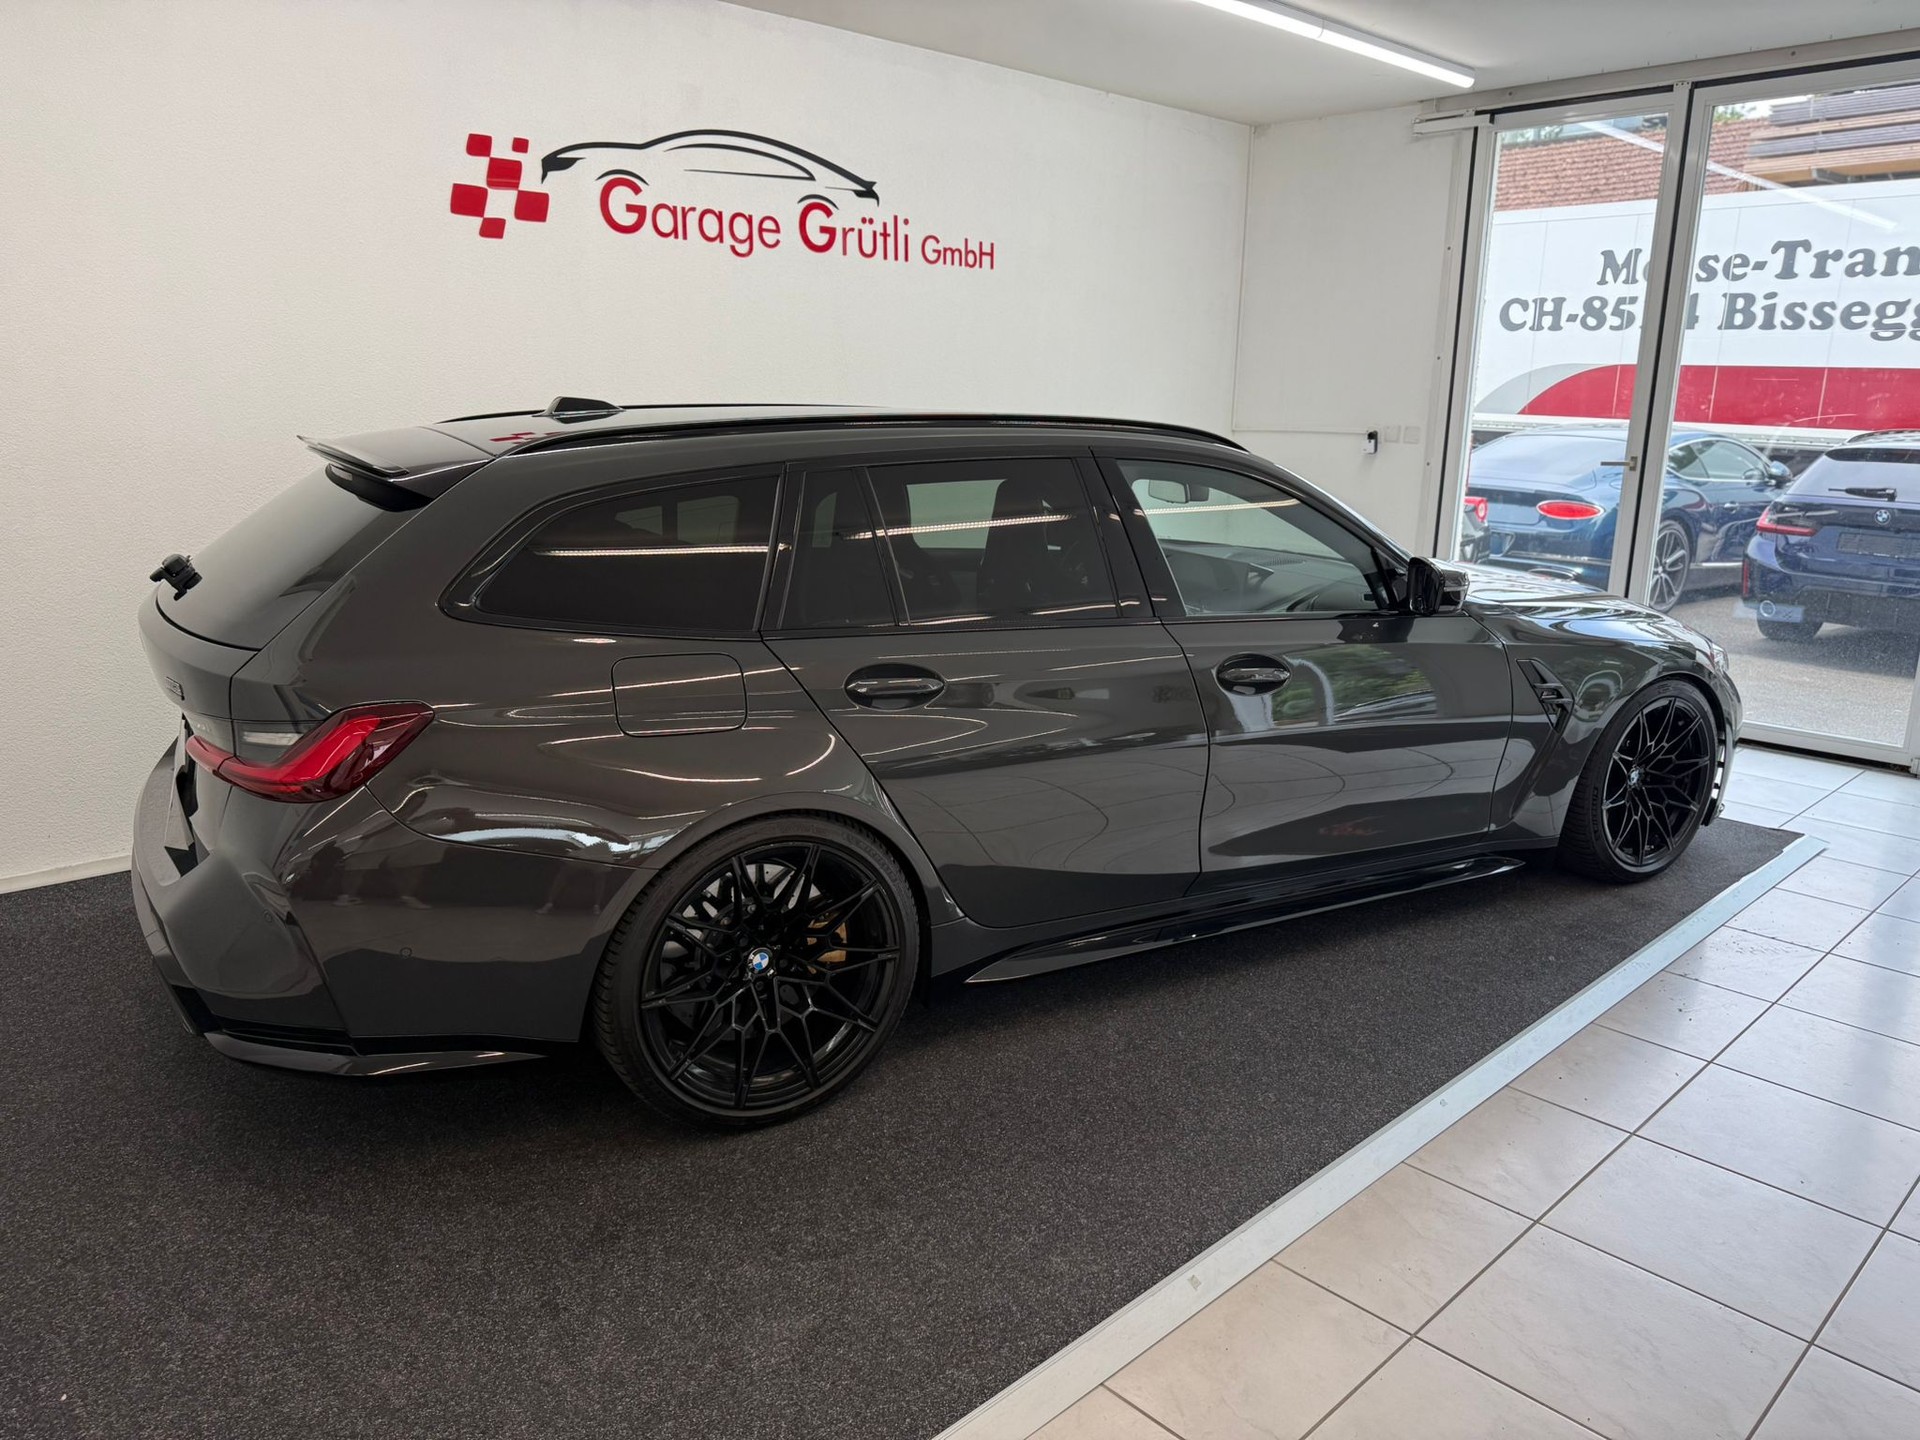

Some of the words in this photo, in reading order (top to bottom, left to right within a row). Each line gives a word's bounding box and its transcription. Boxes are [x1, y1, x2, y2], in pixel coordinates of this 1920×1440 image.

[599, 176, 782, 259] Garage
[798, 200, 911, 264] Grütli
[920, 234, 996, 271] GmbH
[1596, 238, 1920, 286] Mse-Tran
[1499, 292, 1700, 332] CH-854
